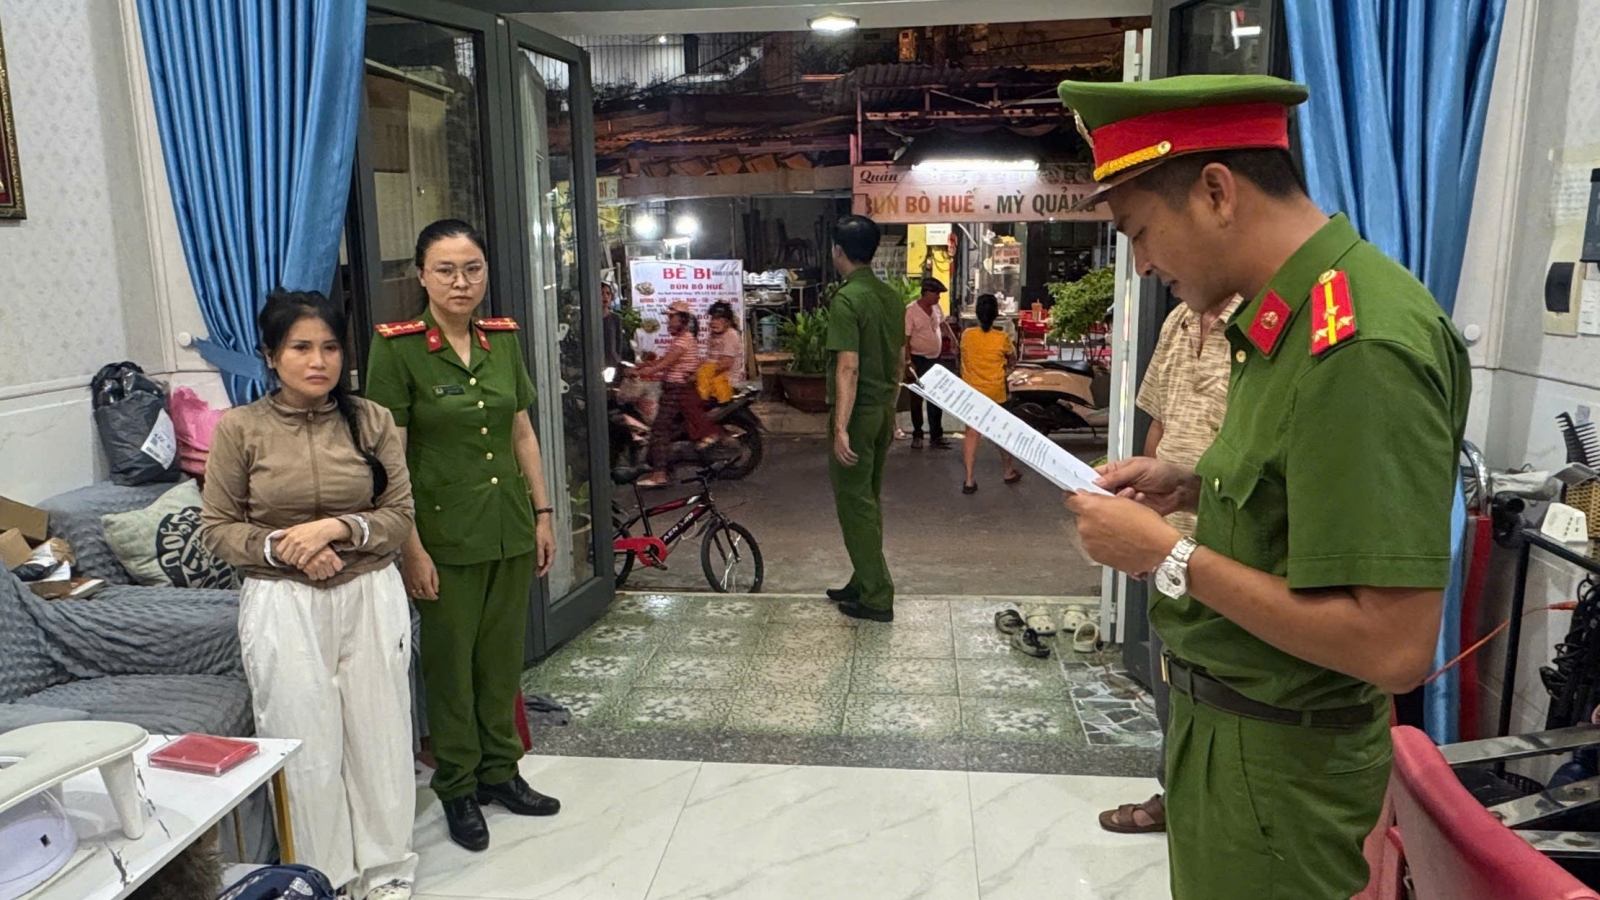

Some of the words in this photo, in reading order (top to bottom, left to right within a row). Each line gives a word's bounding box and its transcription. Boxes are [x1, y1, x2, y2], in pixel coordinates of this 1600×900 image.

[905, 190, 931, 214] BÒ
[938, 188, 976, 213] HUẾ
[996, 189, 1026, 214] MỲ
[693, 267, 711, 280] BI
